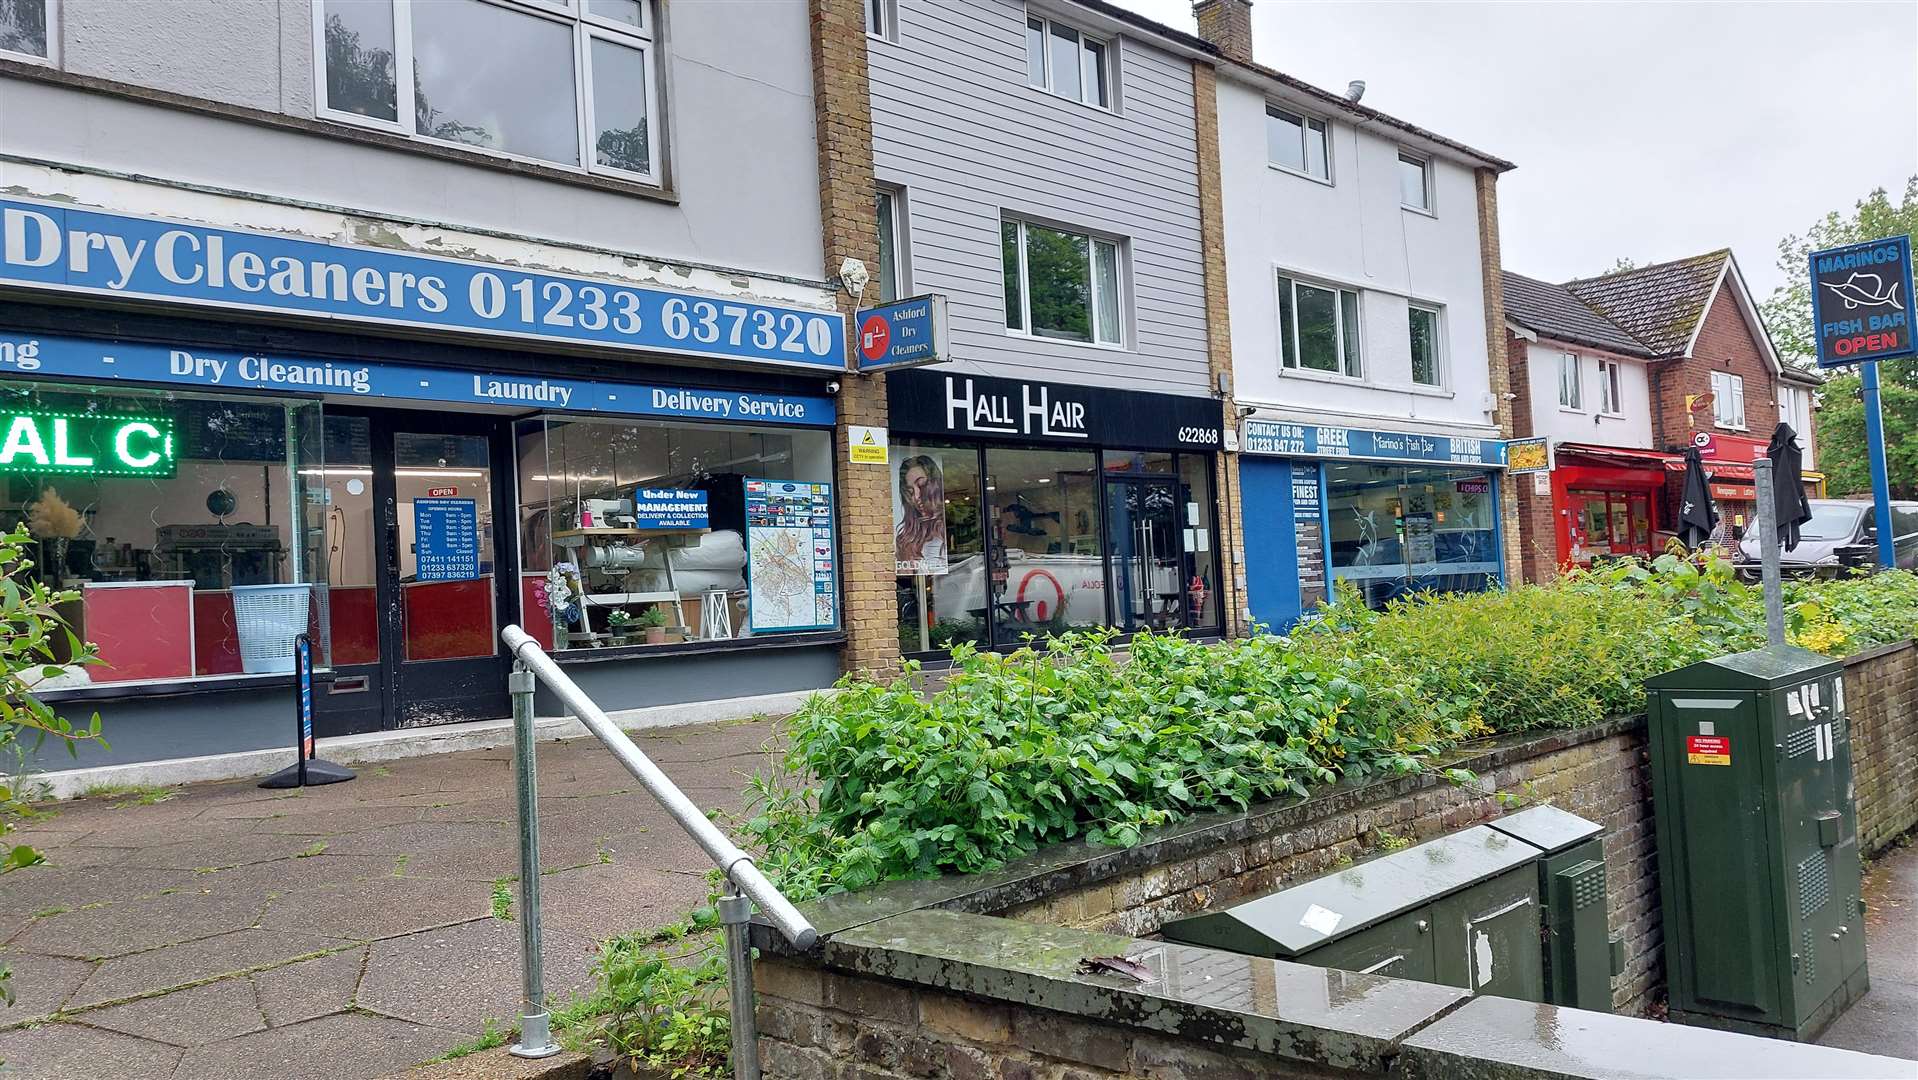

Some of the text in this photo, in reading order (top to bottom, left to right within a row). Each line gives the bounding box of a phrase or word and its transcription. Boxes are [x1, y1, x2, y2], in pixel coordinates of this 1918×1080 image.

[1819, 245, 1899, 273] MARINOS
[468, 272, 642, 335] 01233
[661, 297, 832, 357] 637320
[893, 306, 926, 321] Ashford
[902, 327, 918, 338] Dry
[1824, 312, 1905, 338] FISH BAR
[891, 342, 929, 357] Cleaners
[1834, 332, 1898, 356] OPEN
[0, 340, 41, 370] ng
[170, 350, 228, 382] Dry
[238, 356, 371, 394] Cleaning
[473, 375, 572, 406] Laundry
[652, 388, 733, 418] Delivery
[738, 395, 805, 419] Service
[945, 376, 1088, 438] HALL HAIR
[1178, 426, 1219, 444] 622868
[1247, 423, 1279, 437] CONTACT
[1281, 426, 1291, 438] US
[1316, 427, 1349, 446] GREEK
[1247, 438, 1304, 453] 01233 647 272
[1372, 432, 1436, 457] Marino's Fish Bar
[1449, 438, 1481, 455] BRITISH
[643, 490, 699, 499] Under New
[1293, 486, 1318, 499] FINEST
[637, 503, 708, 512] MANAGEMENT
[421, 555, 474, 563] 07411 141151
[446, 563, 474, 571] 637320
[422, 571, 446, 579] 07397
